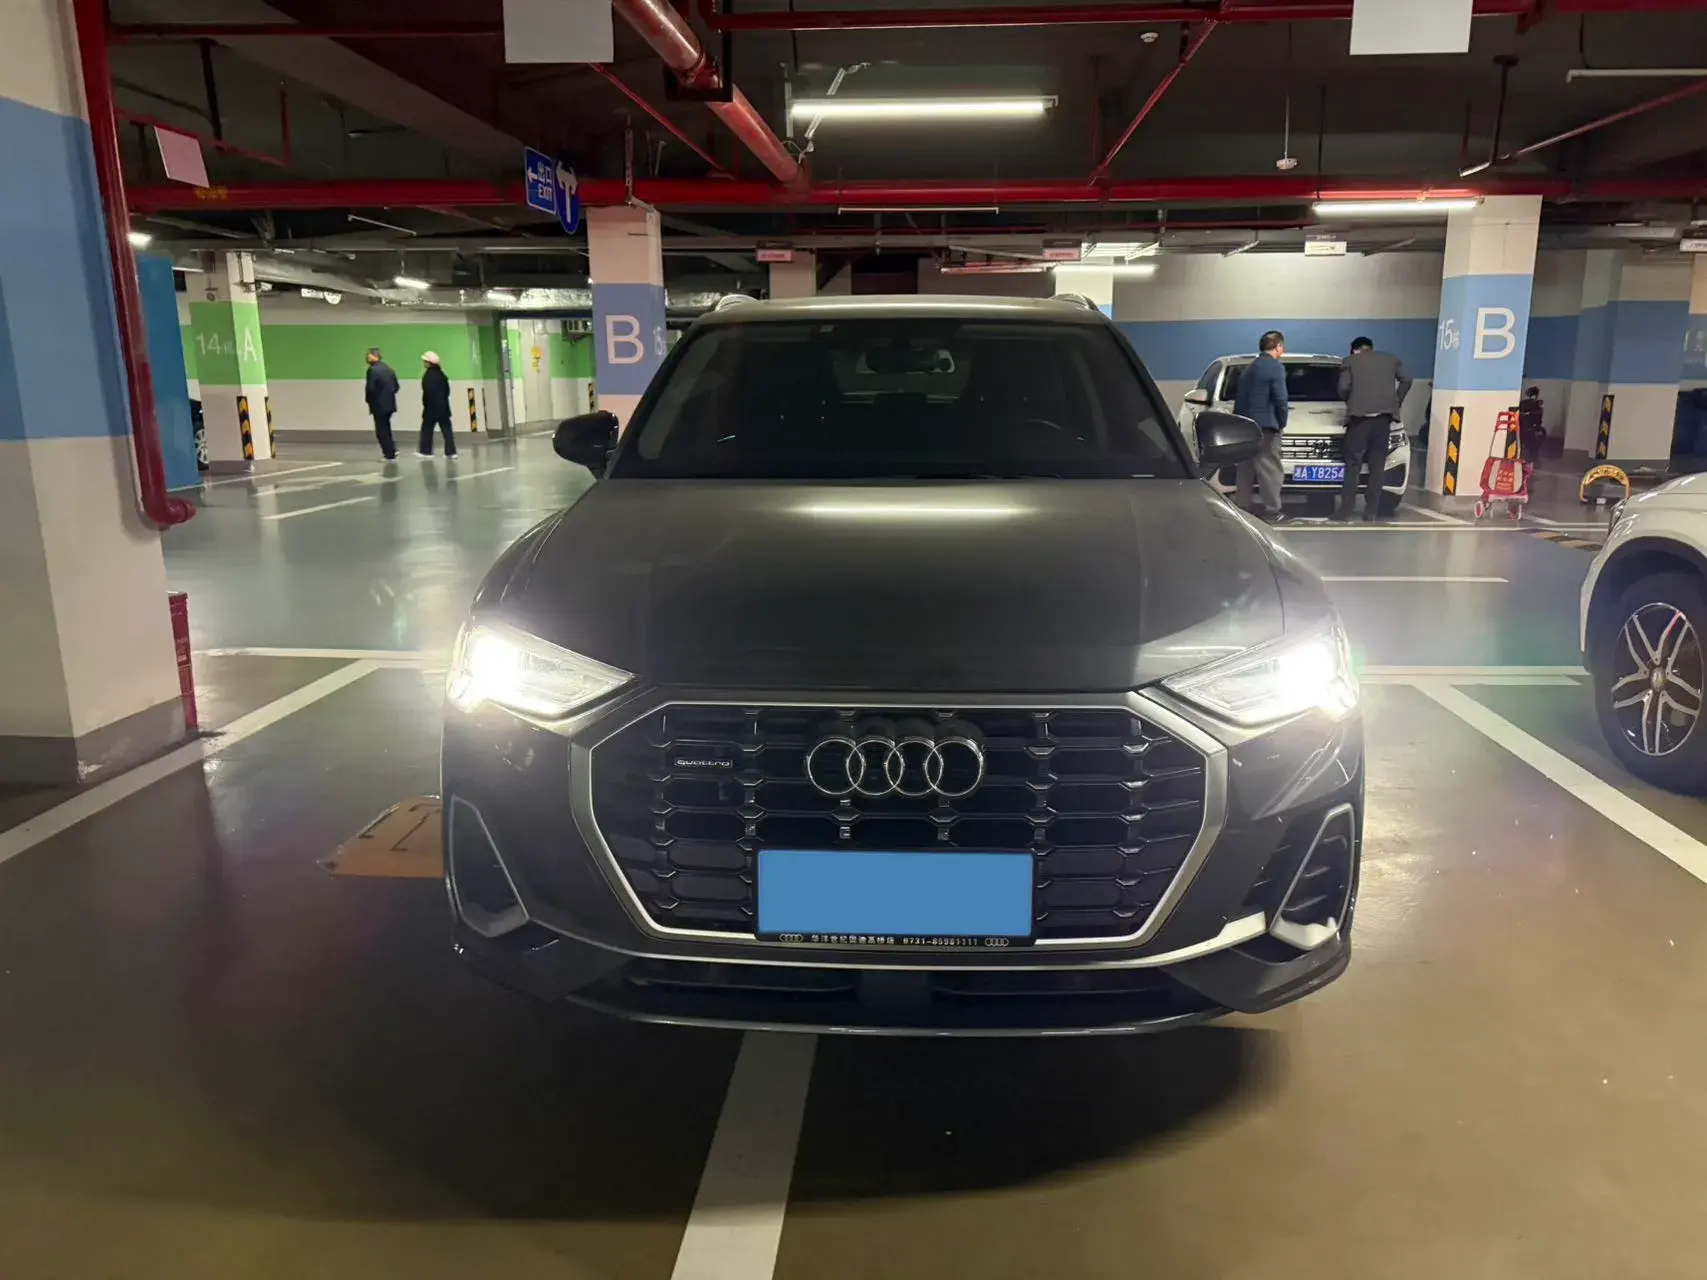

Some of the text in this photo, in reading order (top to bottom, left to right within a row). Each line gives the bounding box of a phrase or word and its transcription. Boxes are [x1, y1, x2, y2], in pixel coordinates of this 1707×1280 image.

[537, 160, 552, 184] 出口
[538, 182, 553, 202] EXIT
[243, 327, 258, 363] A
[605, 314, 645, 364] B
[1473, 307, 1516, 360] B
[676, 759, 731, 768] quattro
